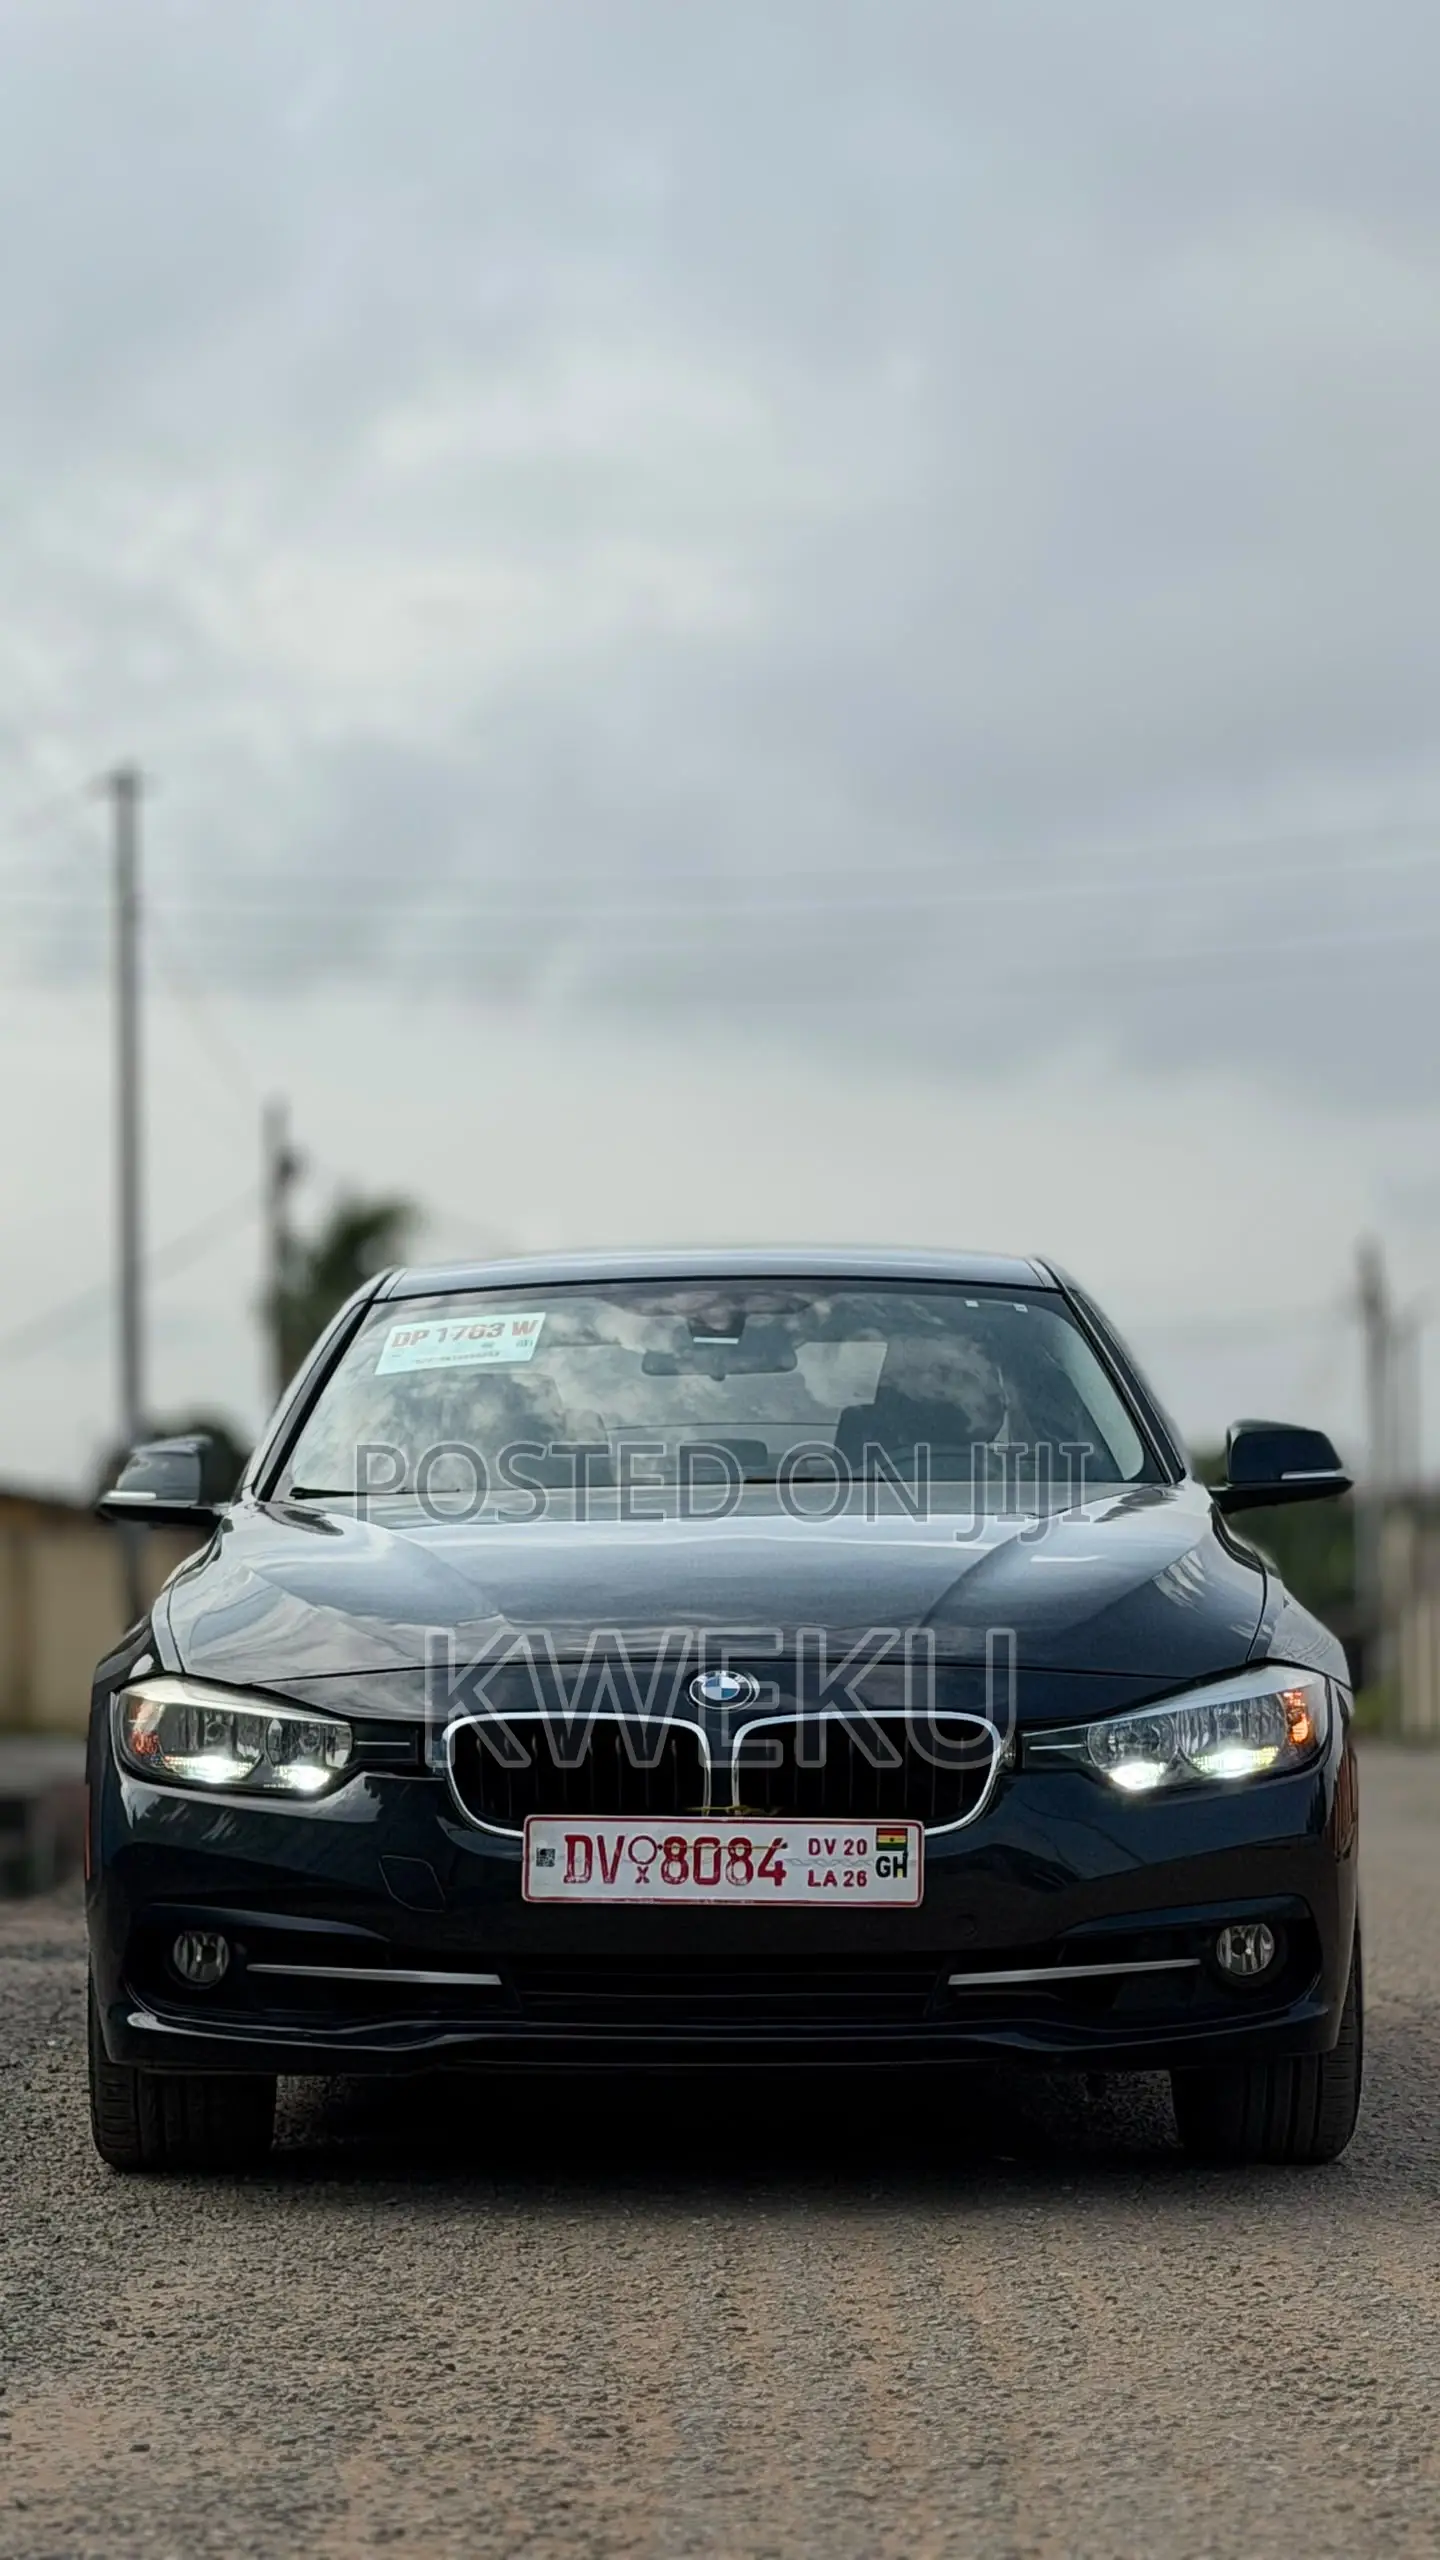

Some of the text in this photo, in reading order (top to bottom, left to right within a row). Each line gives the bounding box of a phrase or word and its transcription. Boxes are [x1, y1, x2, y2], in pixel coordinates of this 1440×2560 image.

[391, 1329, 430, 1348] DP
[511, 1319, 539, 1336] W
[808, 1837, 867, 1856] DV 20
[563, 1834, 787, 1886] DV 8084
[875, 1855, 908, 1879] GH
[807, 1869, 867, 1888] LA 26
